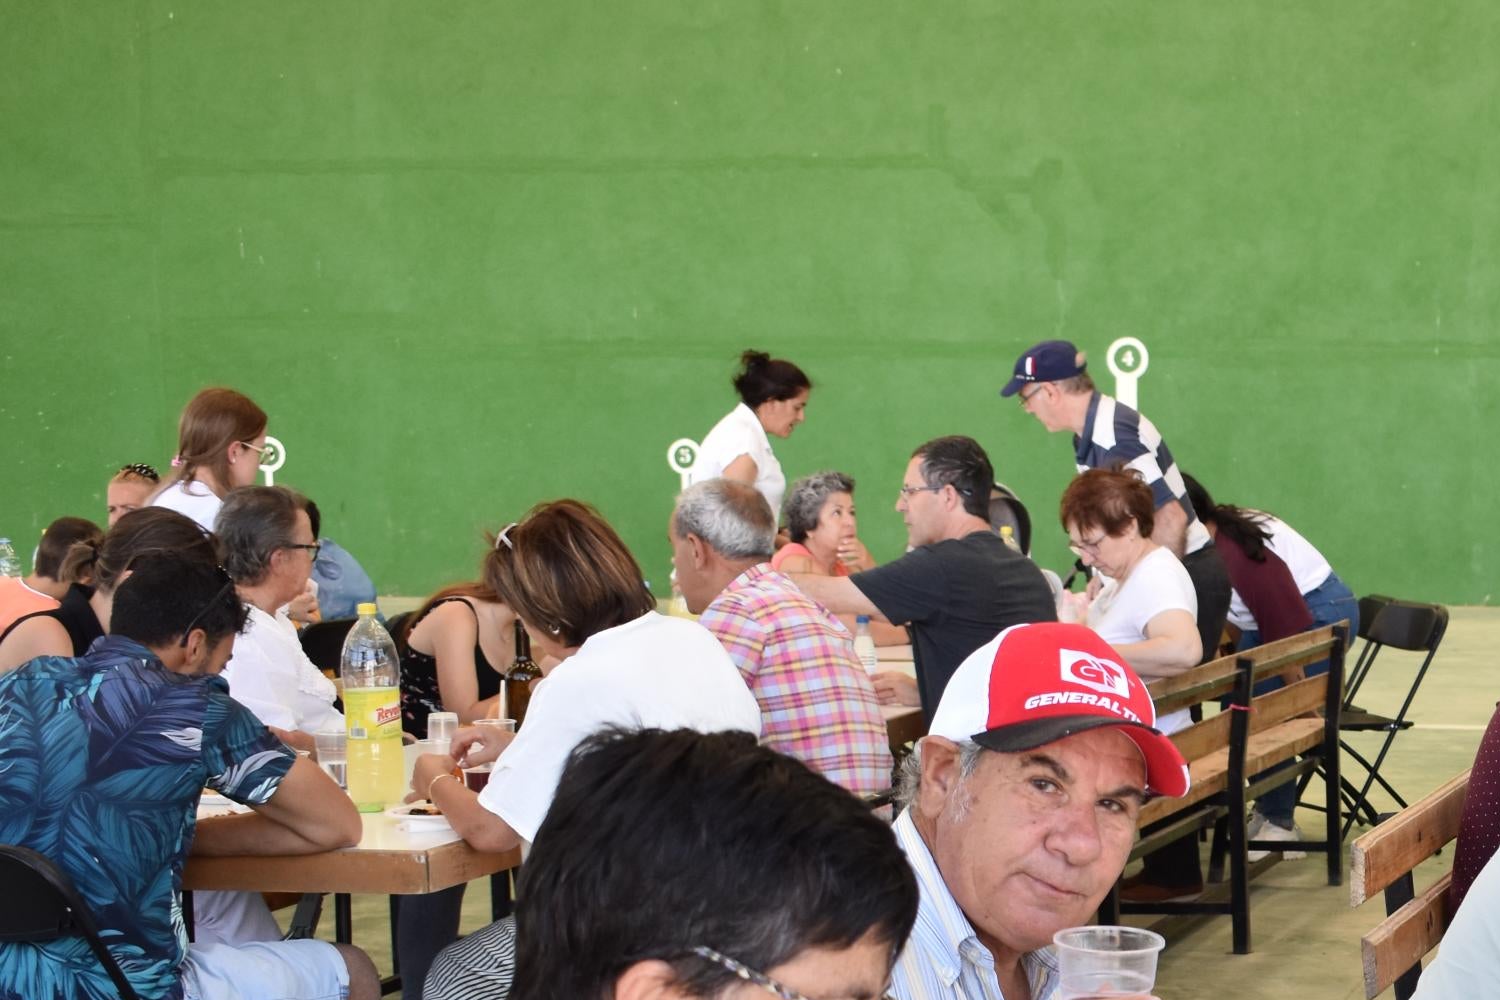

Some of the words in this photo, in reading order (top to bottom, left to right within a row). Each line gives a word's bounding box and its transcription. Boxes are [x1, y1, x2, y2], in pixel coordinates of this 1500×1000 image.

[1122, 350, 1134, 367] 4
[1024, 691, 1121, 715] GENERAL
[1122, 706, 1143, 723] TI
